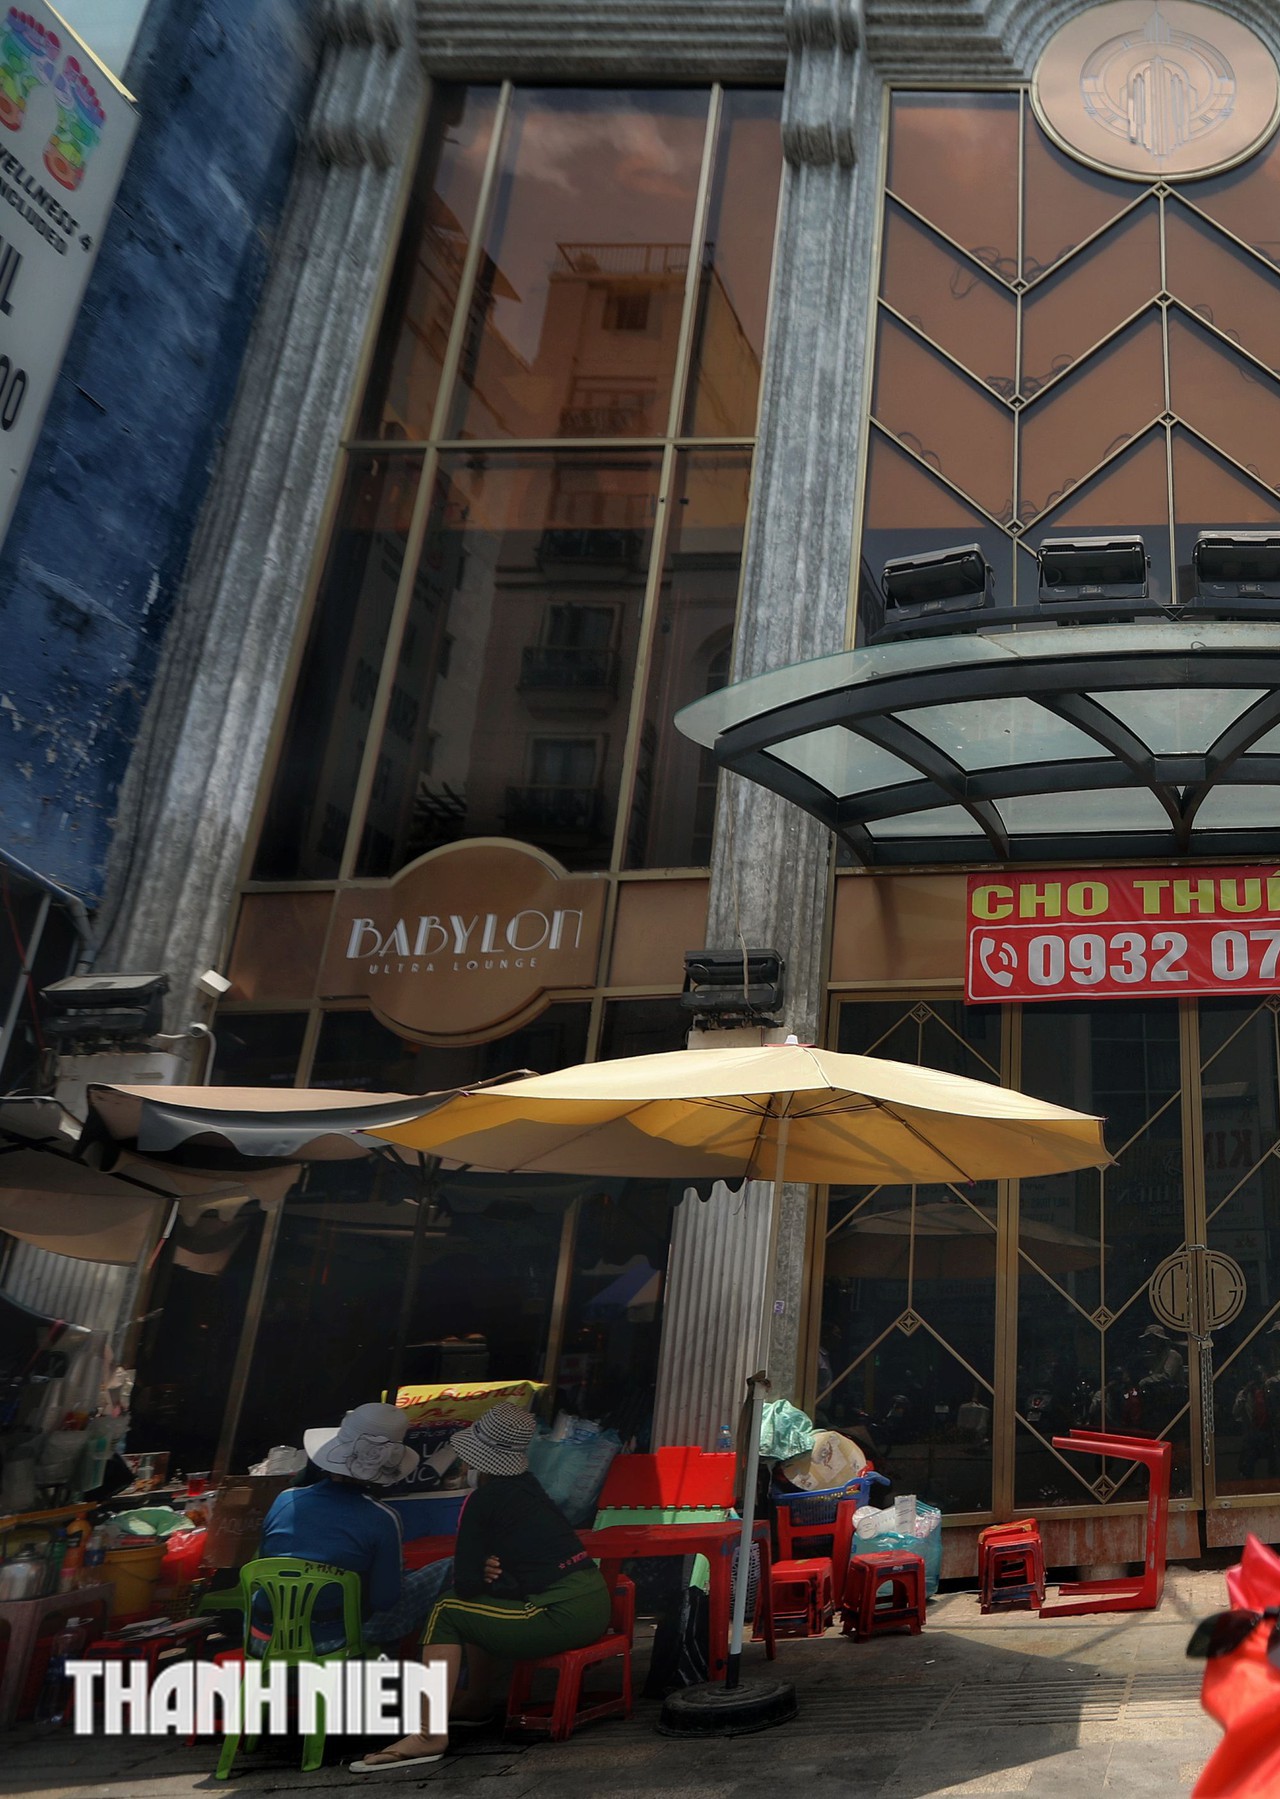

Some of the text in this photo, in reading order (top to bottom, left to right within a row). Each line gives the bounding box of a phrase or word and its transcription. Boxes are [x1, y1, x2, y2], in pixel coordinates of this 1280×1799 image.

[0, 175, 68, 257] NCLUDED
[971, 881, 1109, 920] CHO
[346, 909, 583, 959] BABYLON
[1027, 931, 1189, 986] 0932
[369, 957, 537, 975] ULTRA LOUNGE
